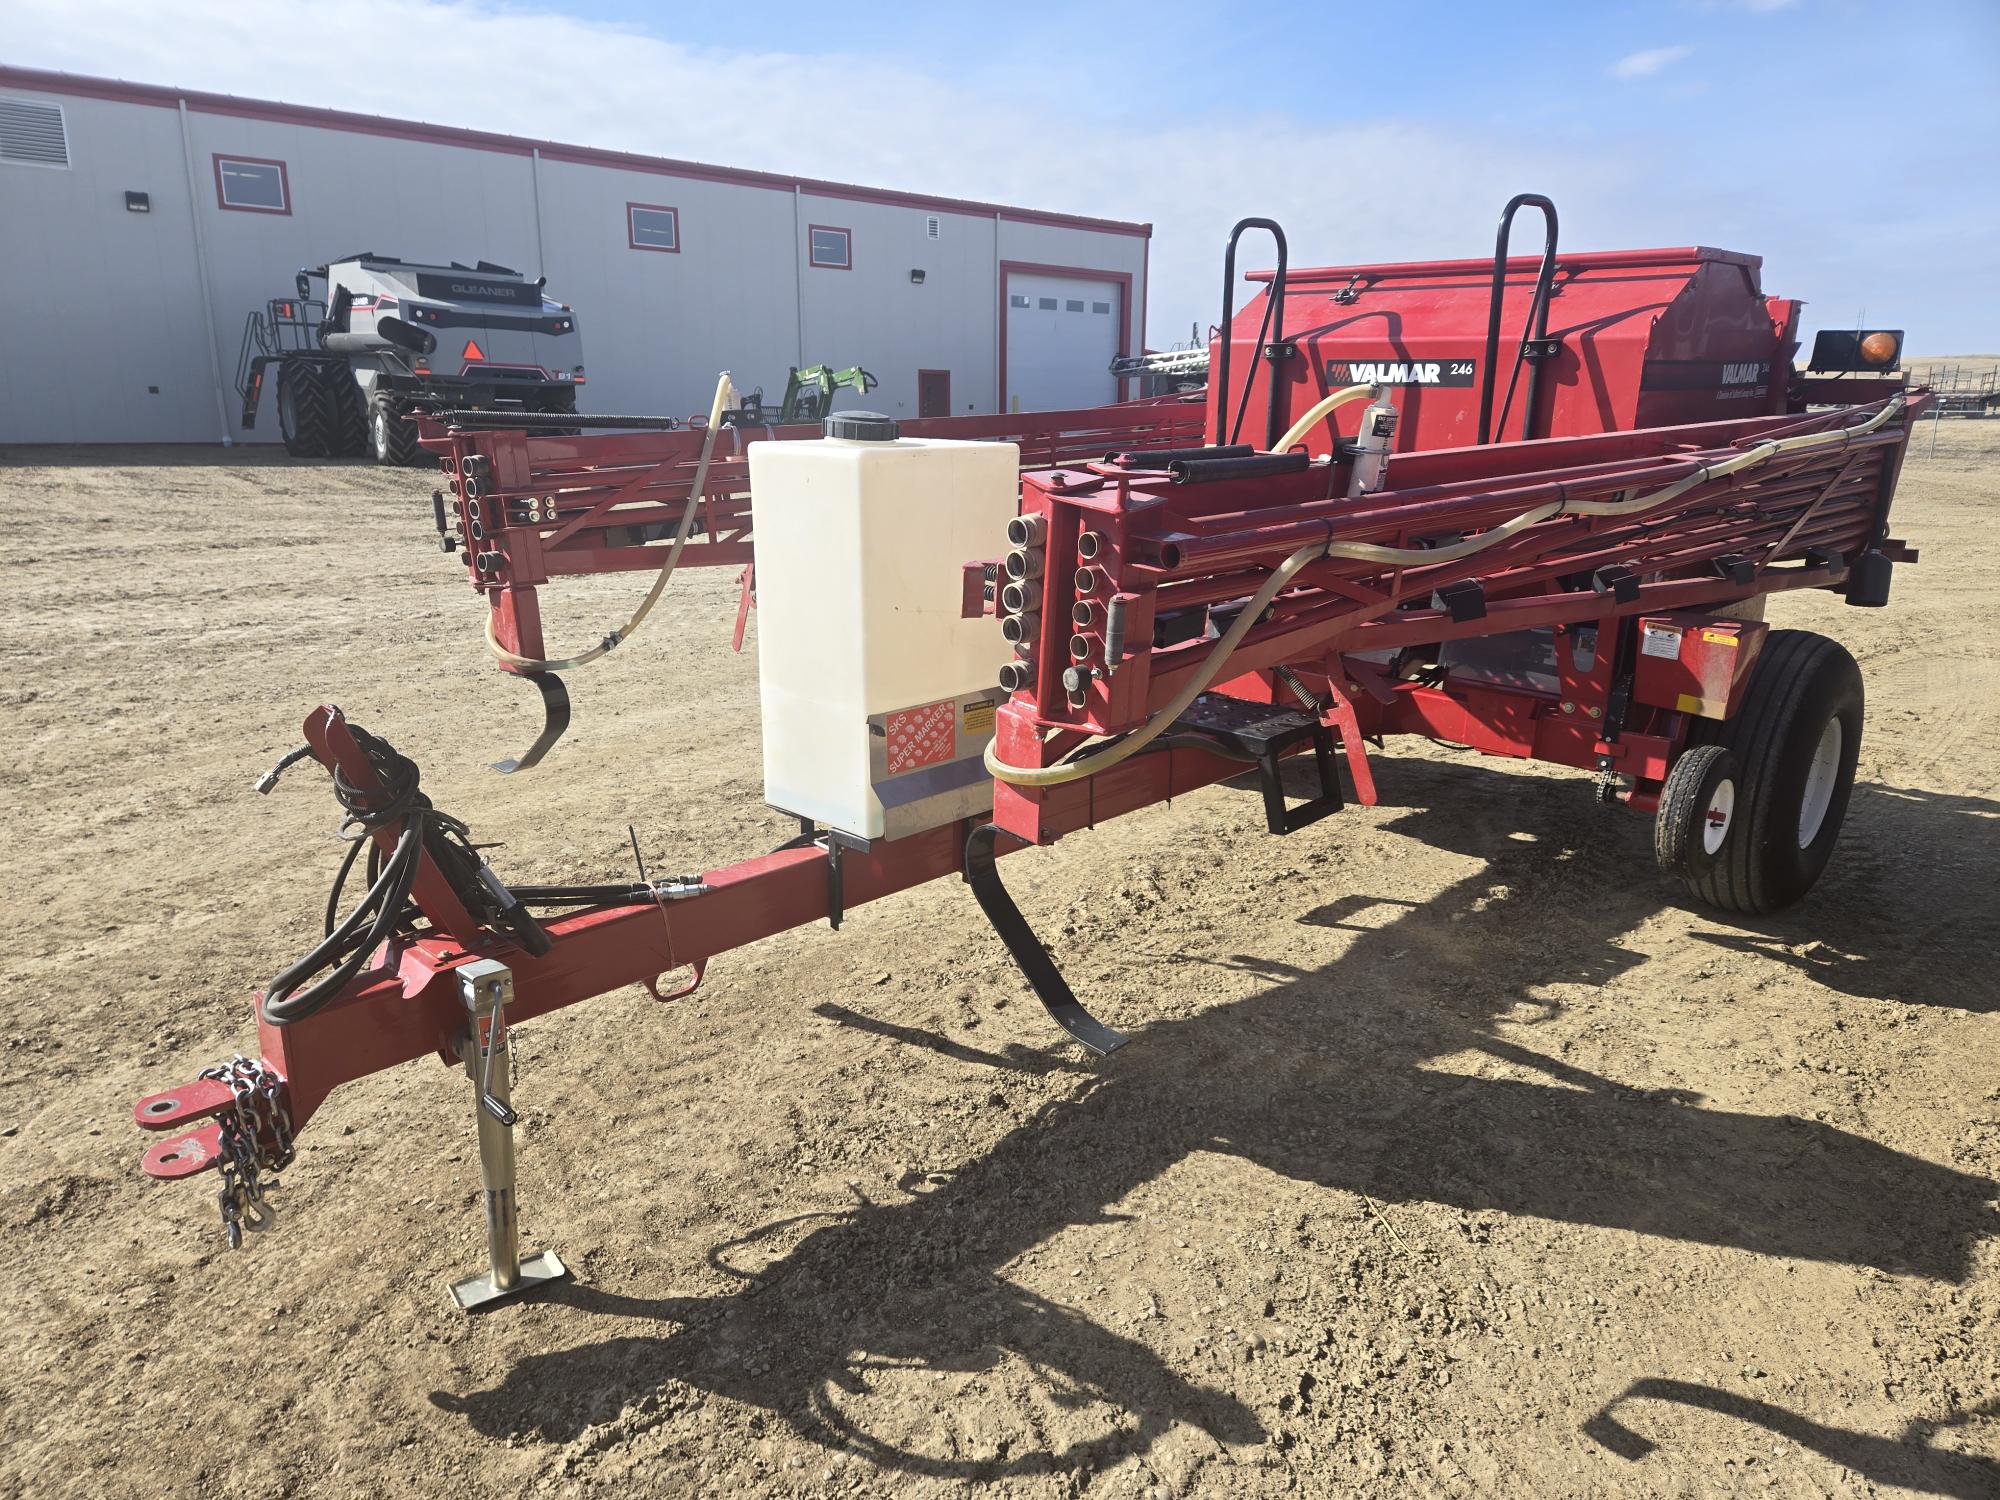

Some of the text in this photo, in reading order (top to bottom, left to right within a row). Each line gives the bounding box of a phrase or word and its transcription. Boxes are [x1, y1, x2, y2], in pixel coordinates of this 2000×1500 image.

[452, 284, 516, 297] GLEANER
[1349, 363, 1473, 383] VALMAR 246
[1722, 363, 1759, 384] VALMAR
[888, 713, 907, 736] SKS
[889, 740, 917, 773] SUPER
[914, 703, 947, 742] MARKER
